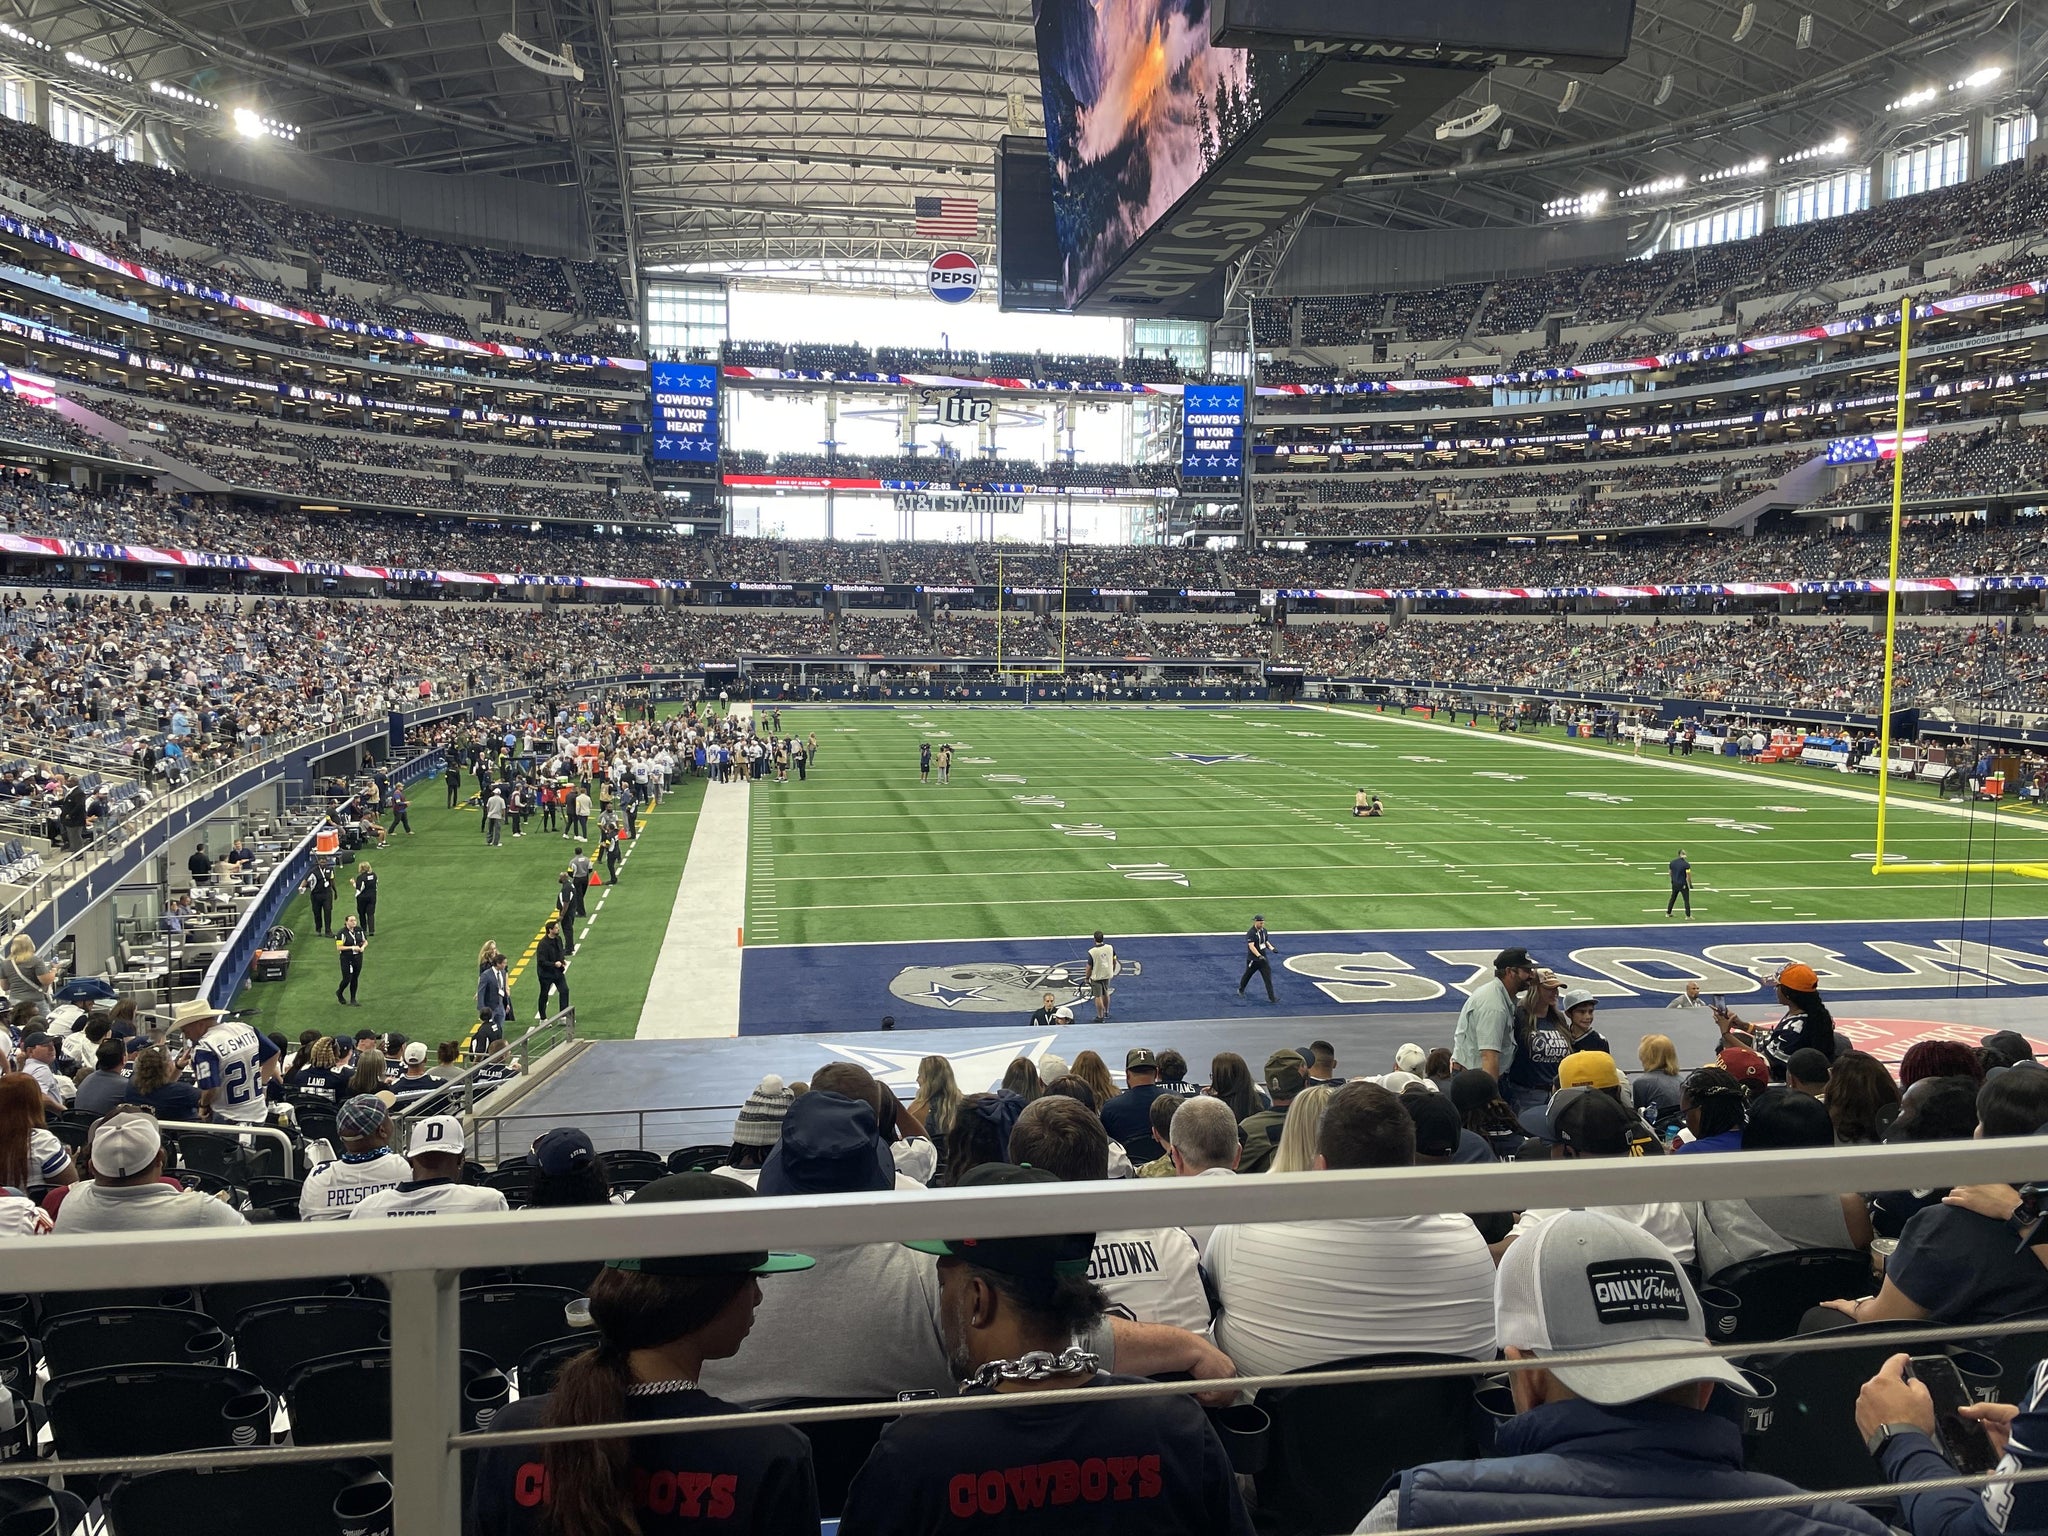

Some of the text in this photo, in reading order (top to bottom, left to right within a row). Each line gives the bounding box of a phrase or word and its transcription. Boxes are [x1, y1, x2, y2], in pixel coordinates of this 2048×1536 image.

[1293, 39, 1554, 68] WINSTAR
[1107, 134, 1387, 297] WINSTAR
[931, 272, 977, 285] PEPSI
[162, 320, 177, 330] TONY
[178, 324, 204, 336] DORSETT
[1776, 336, 1790, 344] BEER
[1936, 341, 1964, 352] DARREN
[1966, 335, 2001, 346] WOODSON
[287, 348, 299, 356] TEX
[300, 350, 331, 361] SCHRAMM
[1823, 362, 1852, 373] JOHNSON
[440, 372, 468, 381] PEARSON
[567, 387, 591, 395] BRANDT
[656, 394, 713, 407] COWBOYS
[663, 407, 707, 420] IN YOUR
[936, 397, 992, 428] Lite
[1187, 415, 1240, 424] COWBOYS
[667, 421, 704, 433] HEART
[1193, 427, 1234, 437] IN YOUR
[1196, 440, 1231, 450] HEART
[900, 481, 906, 489] 0
[895, 495, 1024, 513] AT&T STADIUM
[739, 583, 793, 591] Blockchain.com
[832, 584, 884, 592] Blockchain.com
[1012, 587, 1062, 595] Blockchain.com
[1099, 588, 1148, 596] Blockchain.com
[1187, 589, 1235, 597] Blockchain.com
[1782, 747, 1789, 756] G
[1050, 822, 1116, 837] 20
[1107, 862, 1186, 881] 10
[228, 1031, 257, 1051] SMITH
[1138, 1050, 1146, 1060] T
[479, 1069, 502, 1078] POLLARD
[307, 1076, 325, 1087] LAMB
[426, 1122, 444, 1142] D
[1595, 1279, 1643, 1303] ONLY
[949, 1454, 1162, 1518] COWBOYS
